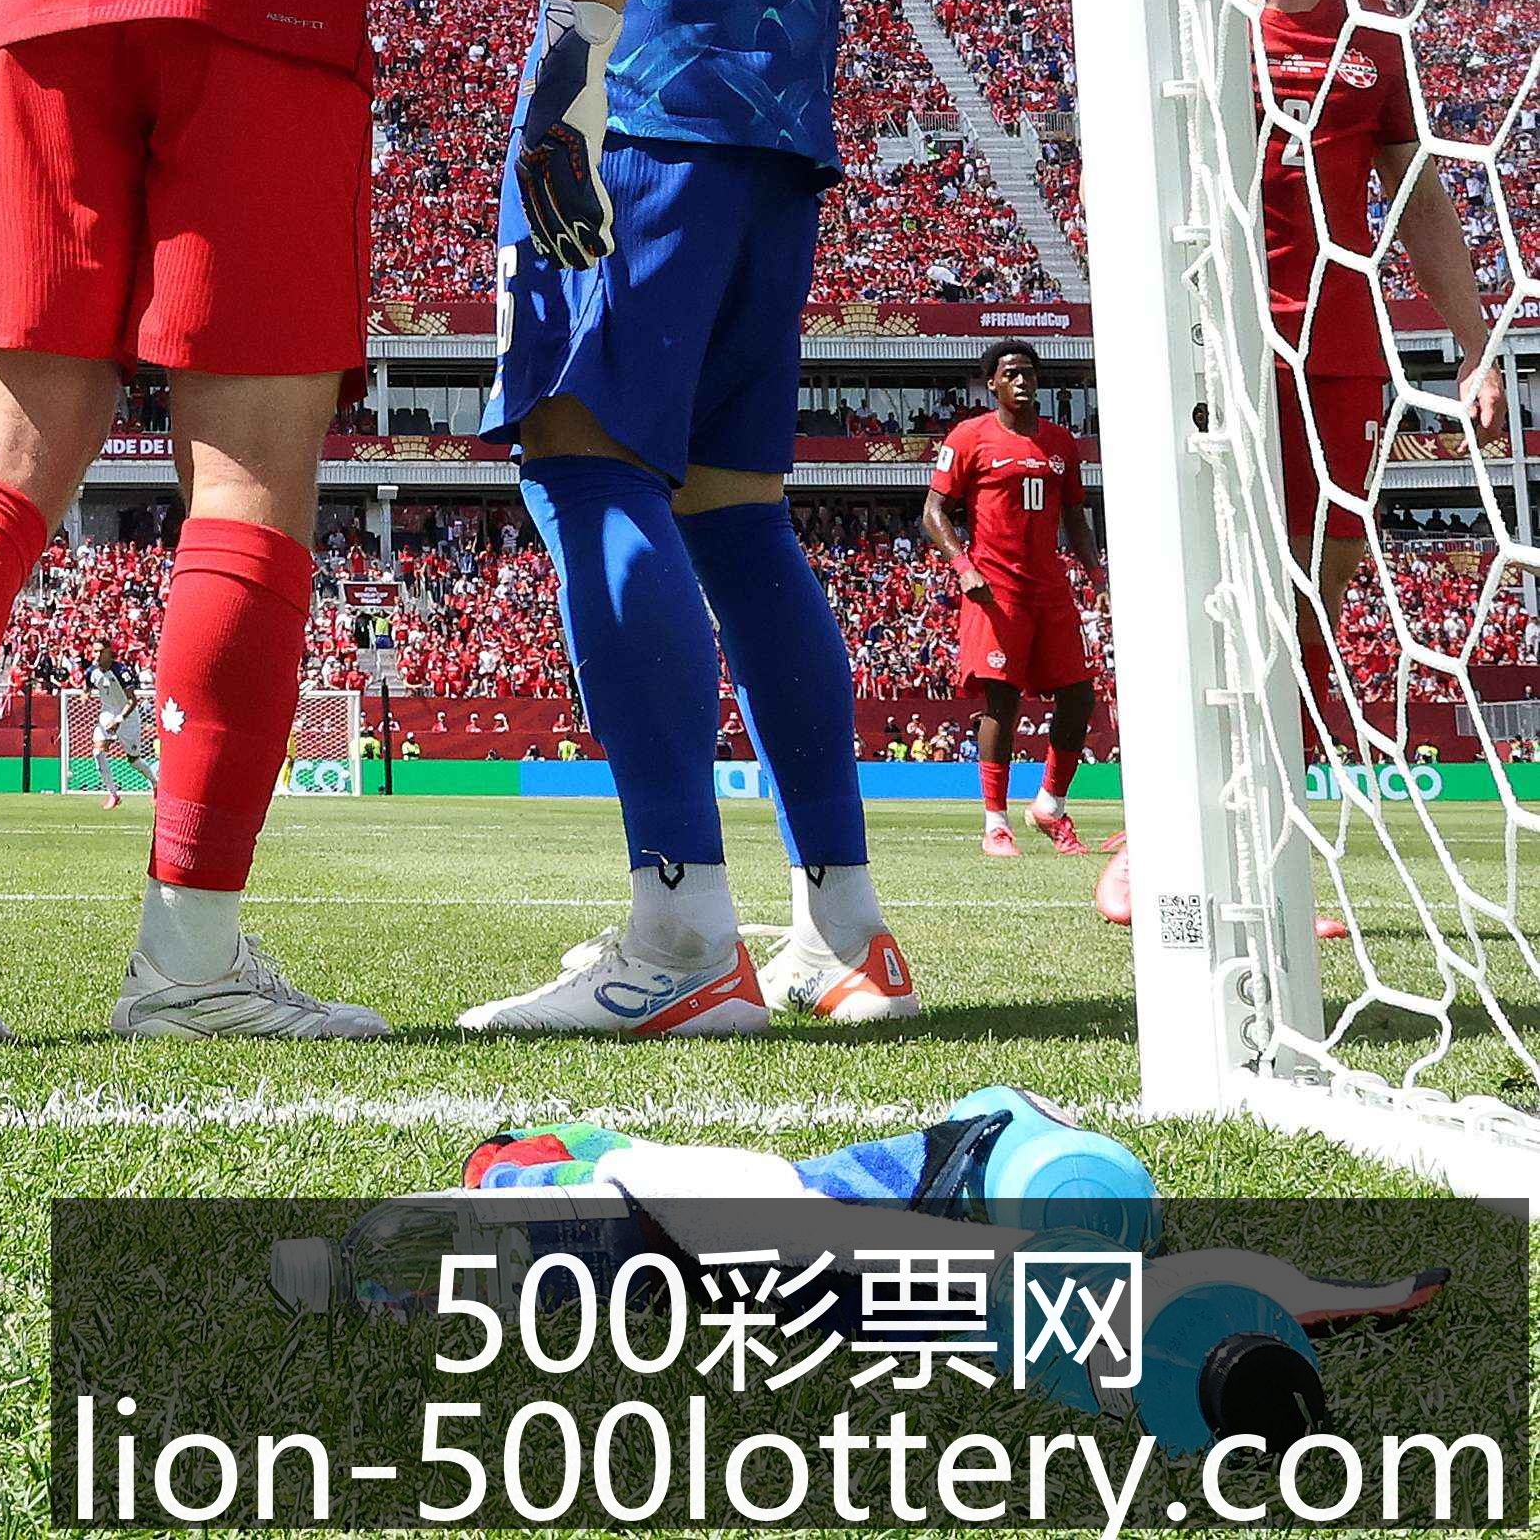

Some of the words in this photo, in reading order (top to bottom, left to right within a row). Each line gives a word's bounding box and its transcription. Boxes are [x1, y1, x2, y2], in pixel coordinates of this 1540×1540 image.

[1489, 302, 1540, 320] WOR
[980, 312, 1070, 329] #FIFAWorldCup
[101, 439, 137, 454] NDE
[140, 439, 164, 454] DE
[1022, 478, 1044, 511] 10
[1306, 764, 1442, 801] amco
